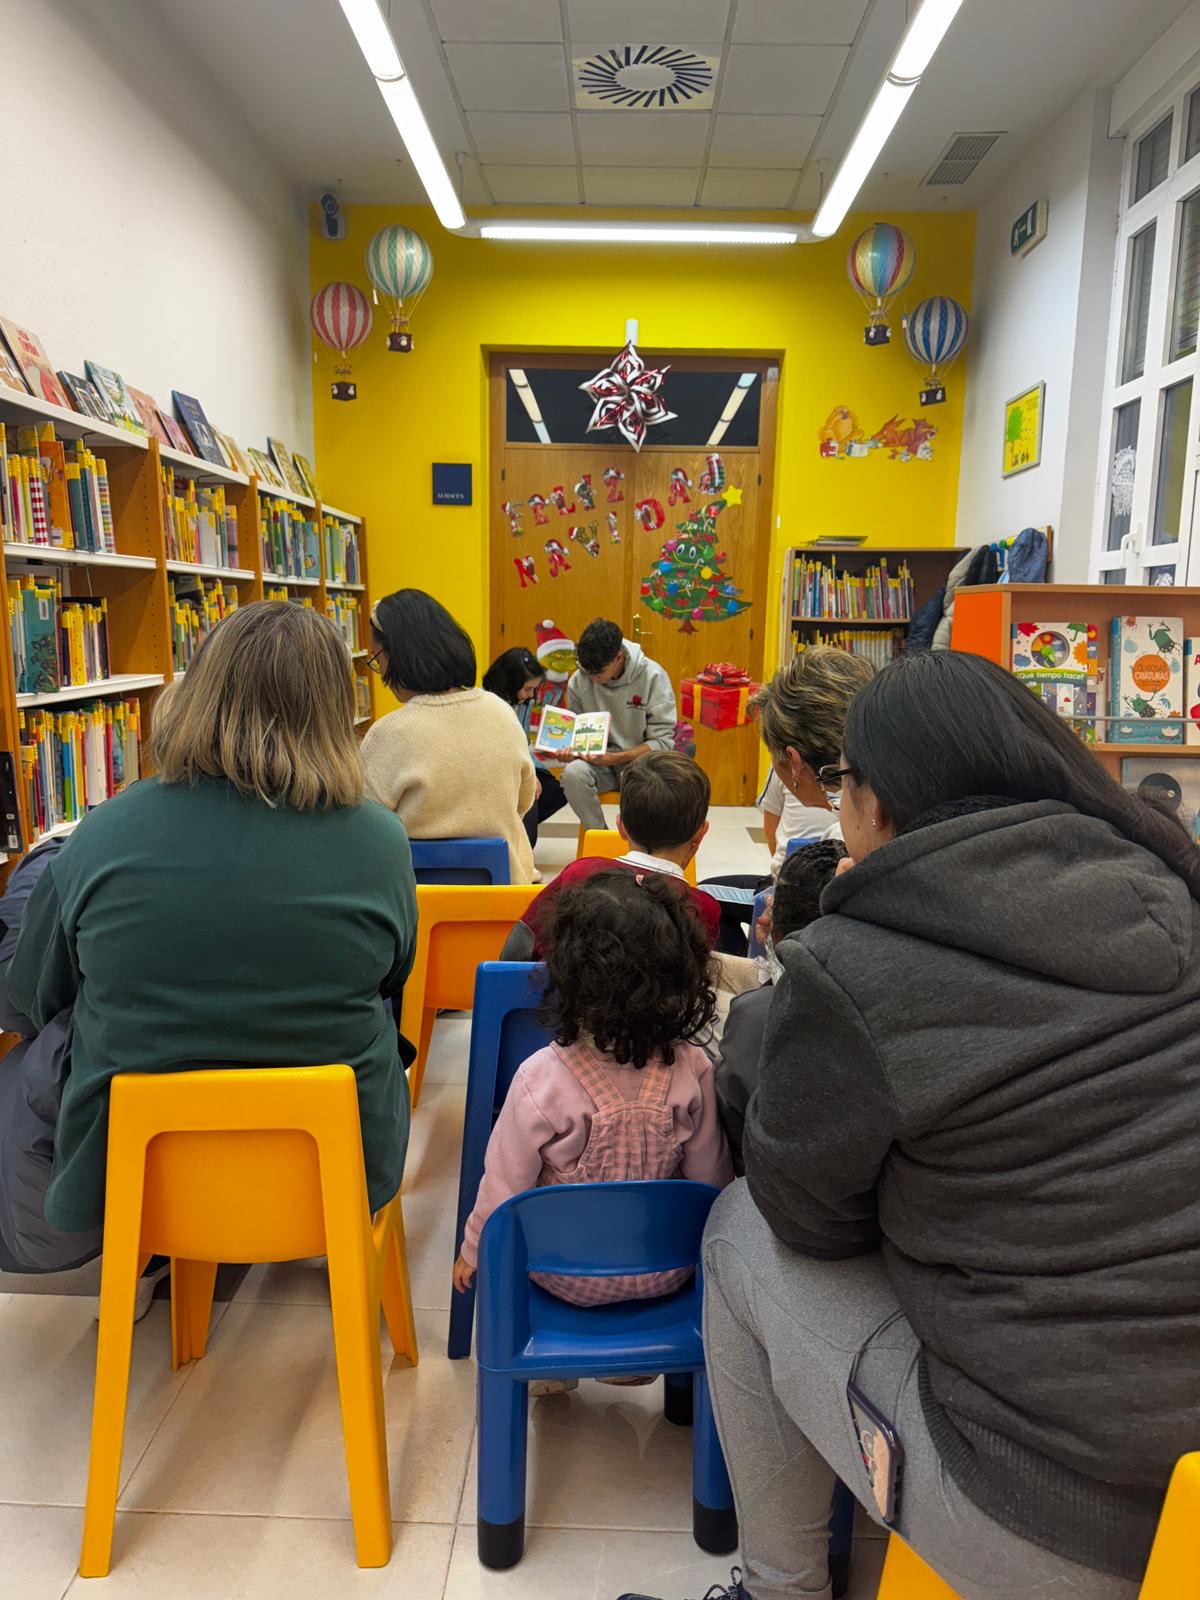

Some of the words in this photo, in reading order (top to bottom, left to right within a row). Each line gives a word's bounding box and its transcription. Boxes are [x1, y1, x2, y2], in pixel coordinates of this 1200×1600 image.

[502, 466, 625, 536] FELIZ
[1036, 671, 1062, 681] tiempo
[1063, 671, 1085, 681] hace?
[1134, 671, 1169, 680] CRIATURAS
